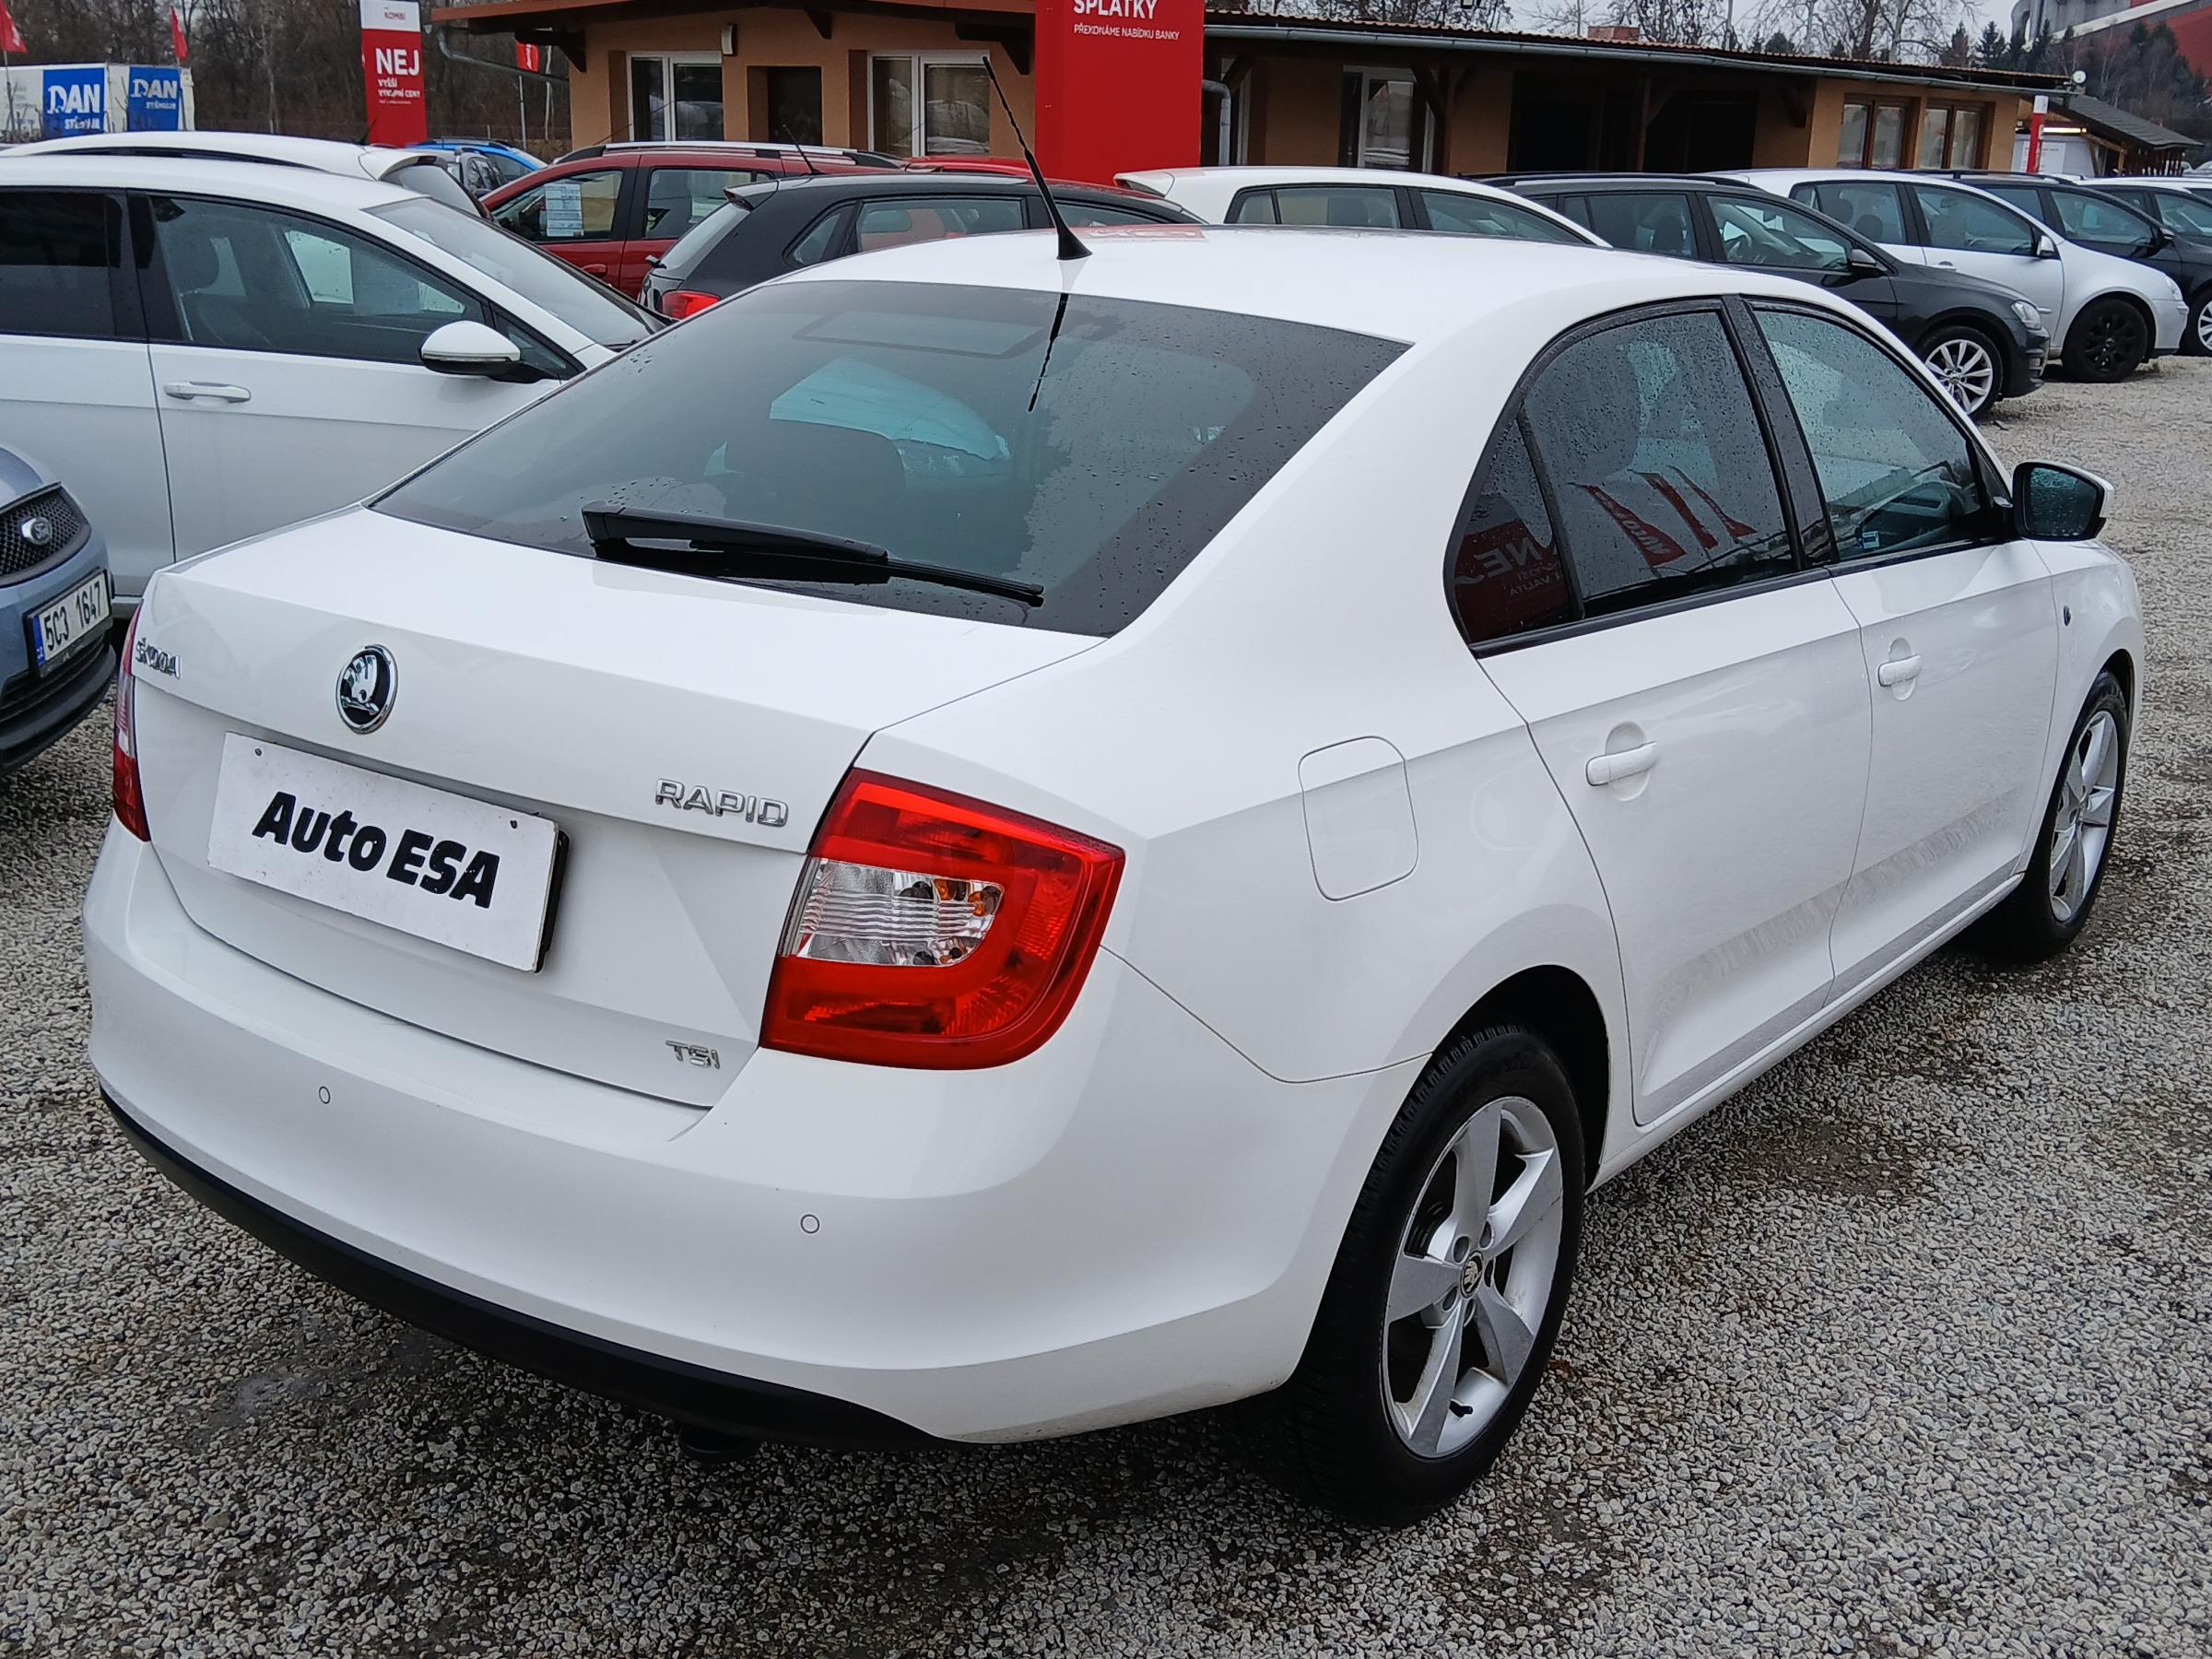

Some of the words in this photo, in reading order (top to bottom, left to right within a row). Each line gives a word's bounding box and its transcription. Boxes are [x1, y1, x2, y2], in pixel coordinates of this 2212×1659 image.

[1074, 23, 1121, 37] PŘEKONÁME
[1122, 27, 1154, 40] NABÍDKU
[1155, 29, 1180, 41] BANKY
[375, 47, 420, 76] NEJ
[47, 83, 101, 114] DAN
[130, 78, 178, 100] DAN
[43, 606, 70, 652] 5C3
[75, 580, 101, 629] 1647
[654, 778, 789, 828] RAPID
[252, 791, 387, 872] Auto
[385, 829, 500, 909] ESA
[665, 1040, 721, 1069] TSI
